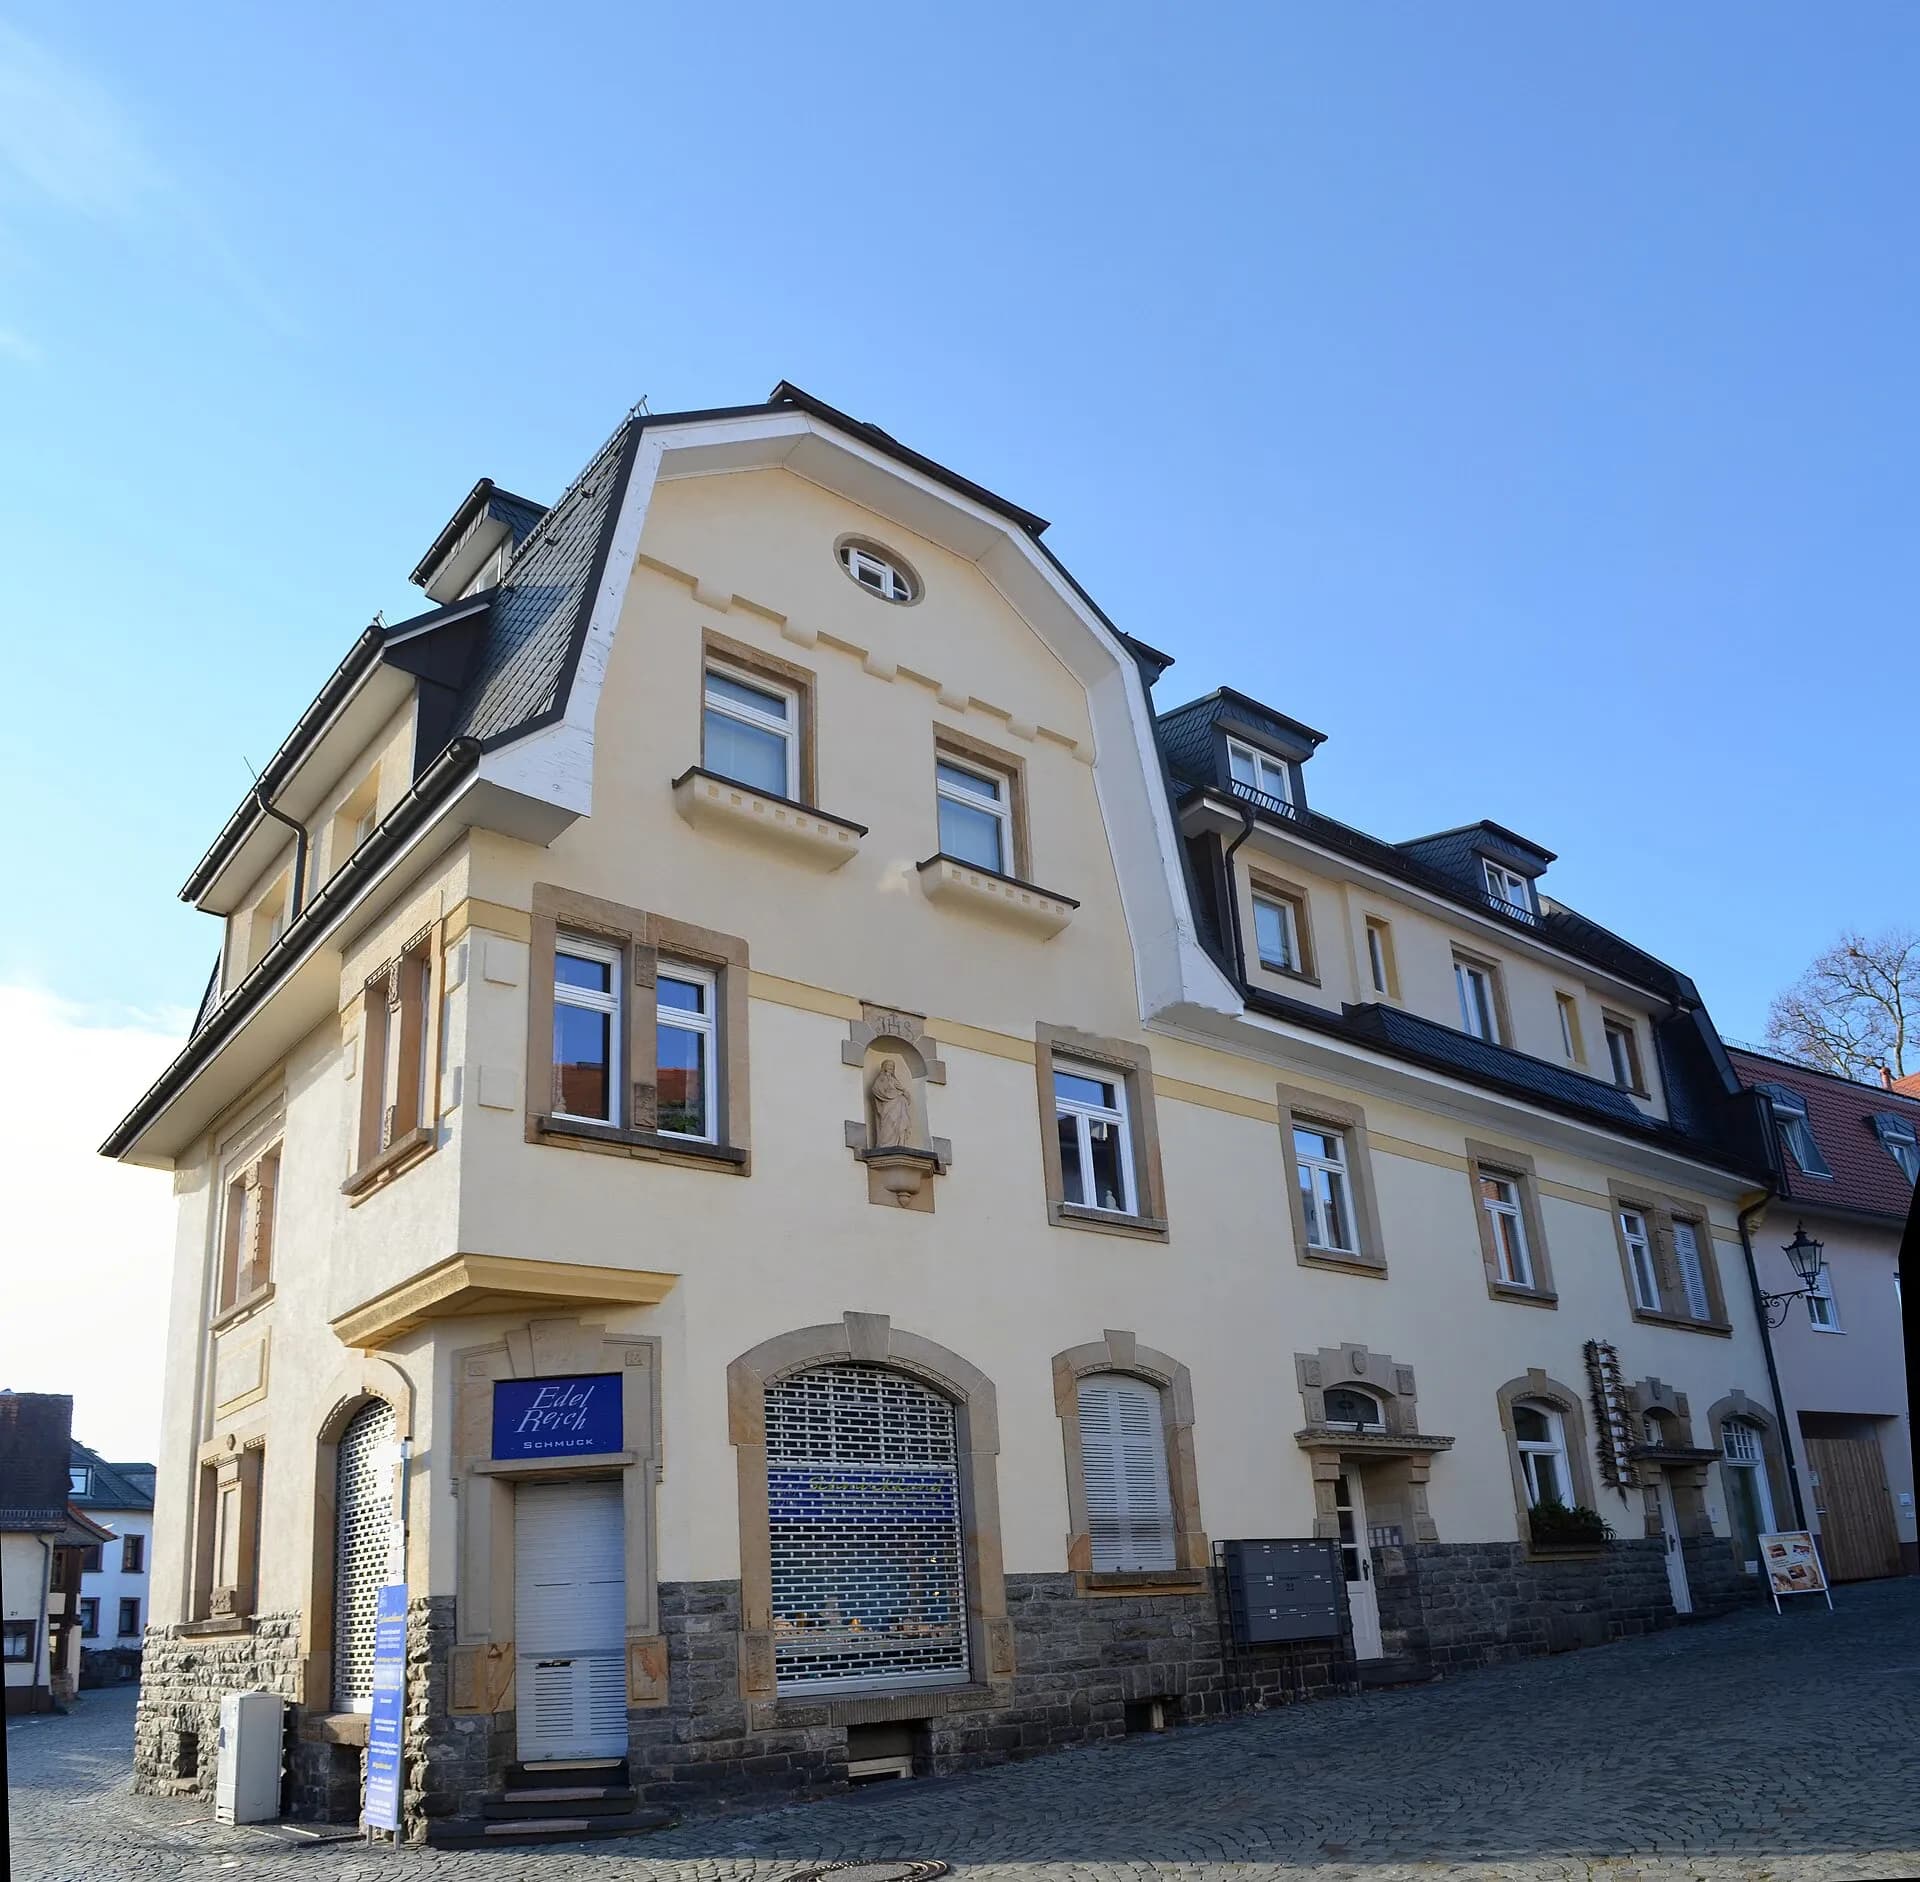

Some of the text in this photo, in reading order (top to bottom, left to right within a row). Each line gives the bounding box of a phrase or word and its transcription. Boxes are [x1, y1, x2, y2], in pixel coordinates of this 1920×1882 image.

[528, 1384, 595, 1409] Edel
[513, 1407, 588, 1433] Reich
[523, 1438, 593, 1449] SCHMUCK
